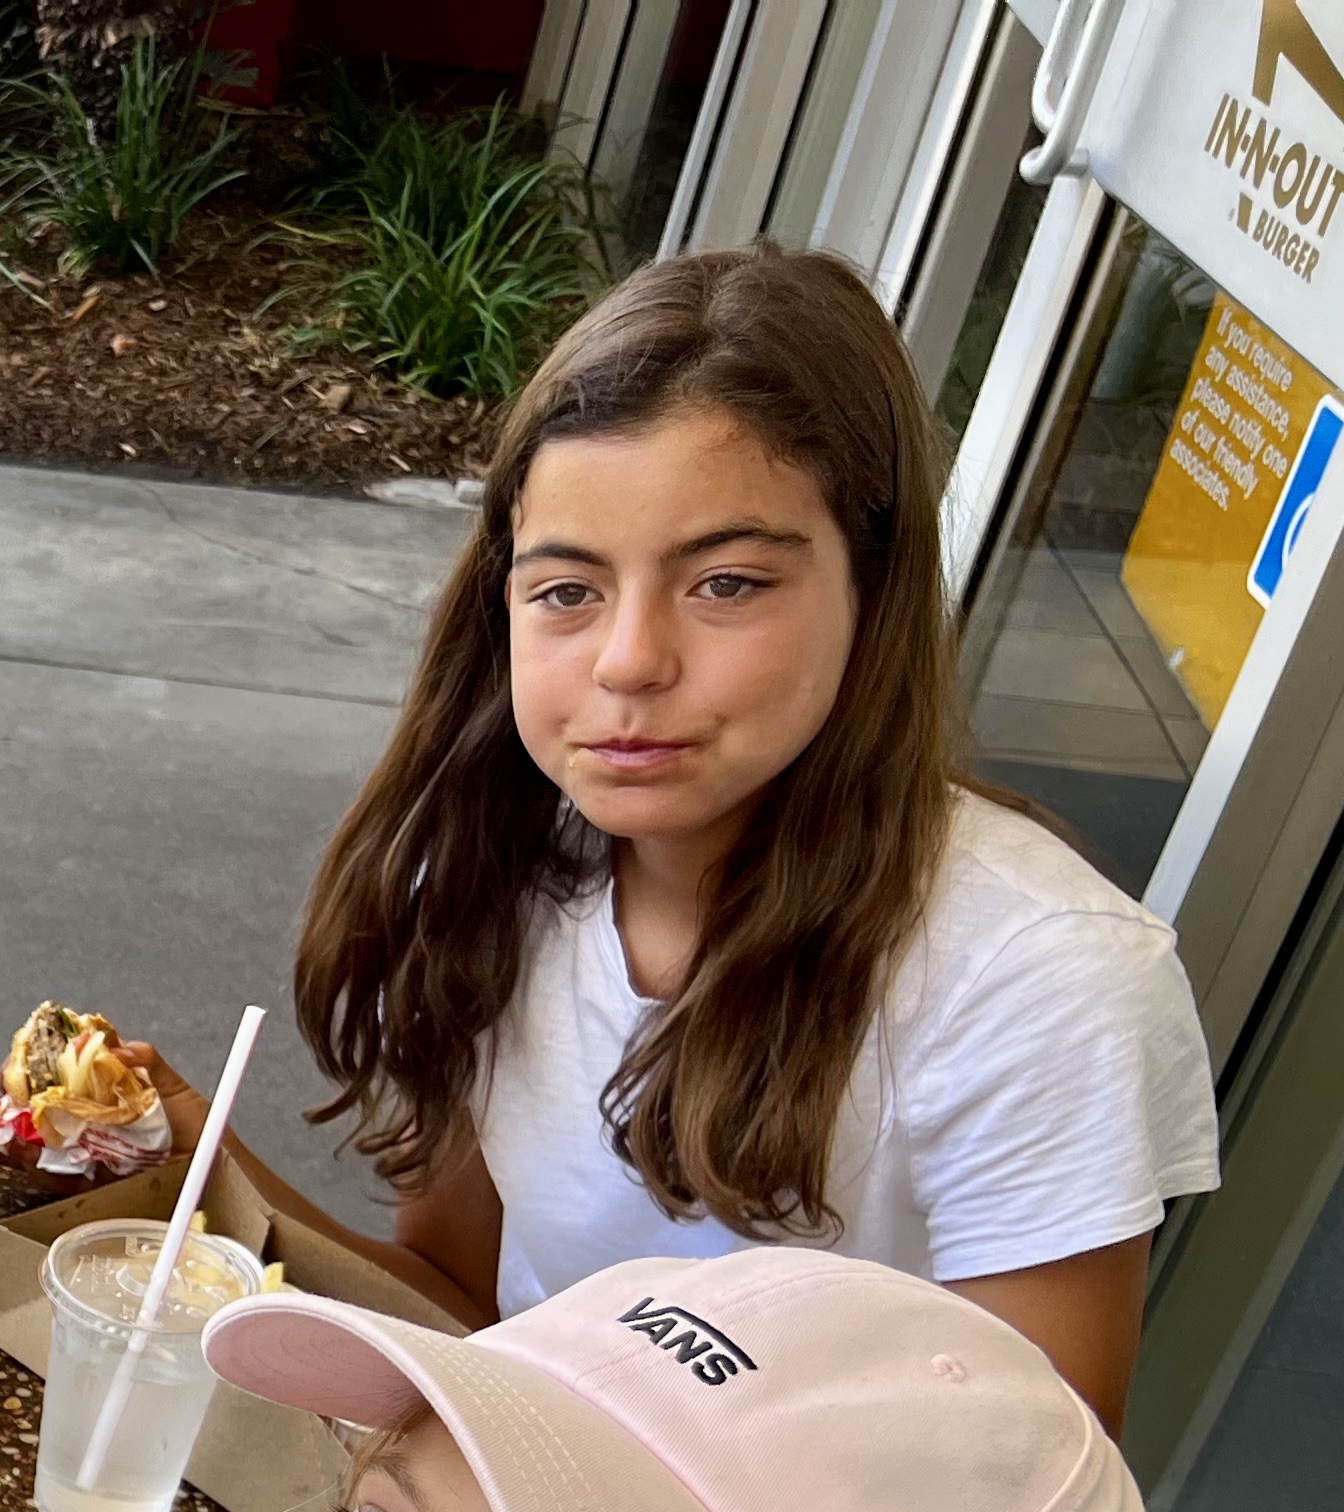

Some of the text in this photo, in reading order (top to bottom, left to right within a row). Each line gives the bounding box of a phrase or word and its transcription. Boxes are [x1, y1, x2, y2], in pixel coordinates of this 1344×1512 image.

[1252, 208, 1320, 284] BURGER
[1205, 345, 1290, 442] any assistance,
[1216, 307, 1293, 393] If you require
[1181, 408, 1259, 500] of our friendly
[1190, 377, 1289, 480] please notify one
[616, 1296, 759, 1387] VANS
